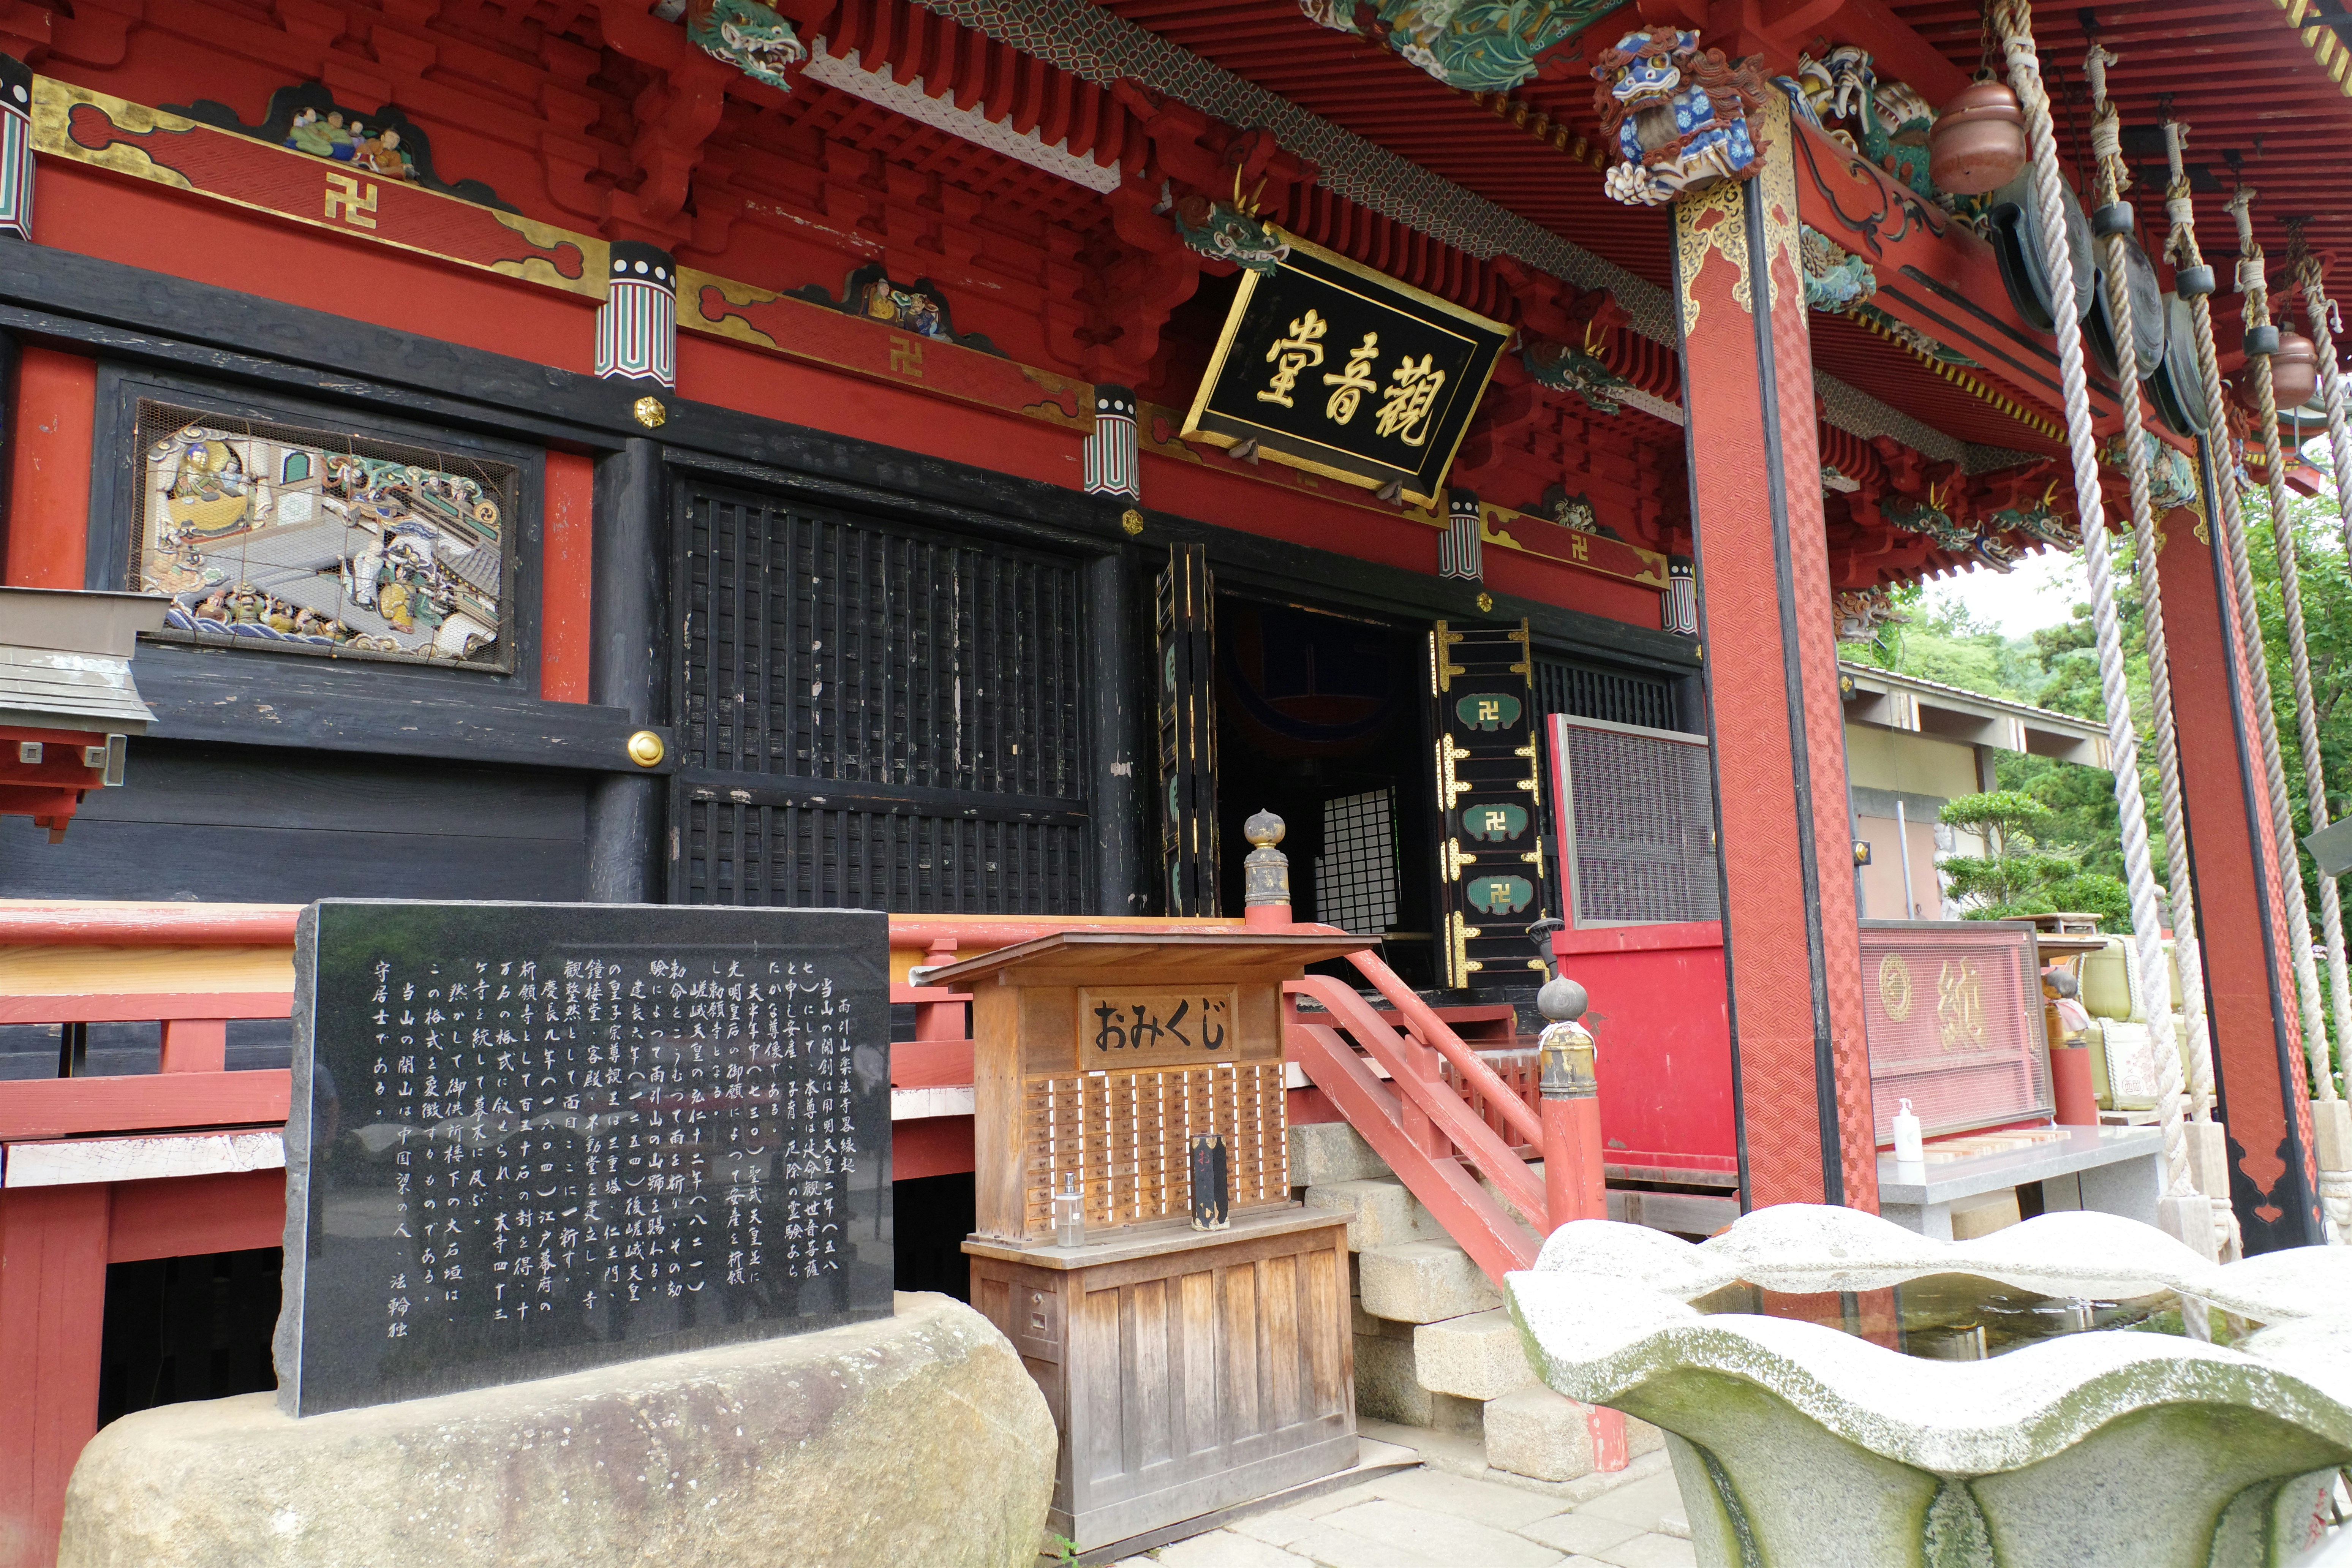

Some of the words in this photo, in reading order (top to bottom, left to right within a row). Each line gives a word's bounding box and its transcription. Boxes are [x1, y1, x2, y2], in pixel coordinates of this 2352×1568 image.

[371, 960, 390, 1115] 守居士である。
[764, 961, 784, 1133] たかな尊像である。
[1093, 997, 1226, 1052] おみくじ
